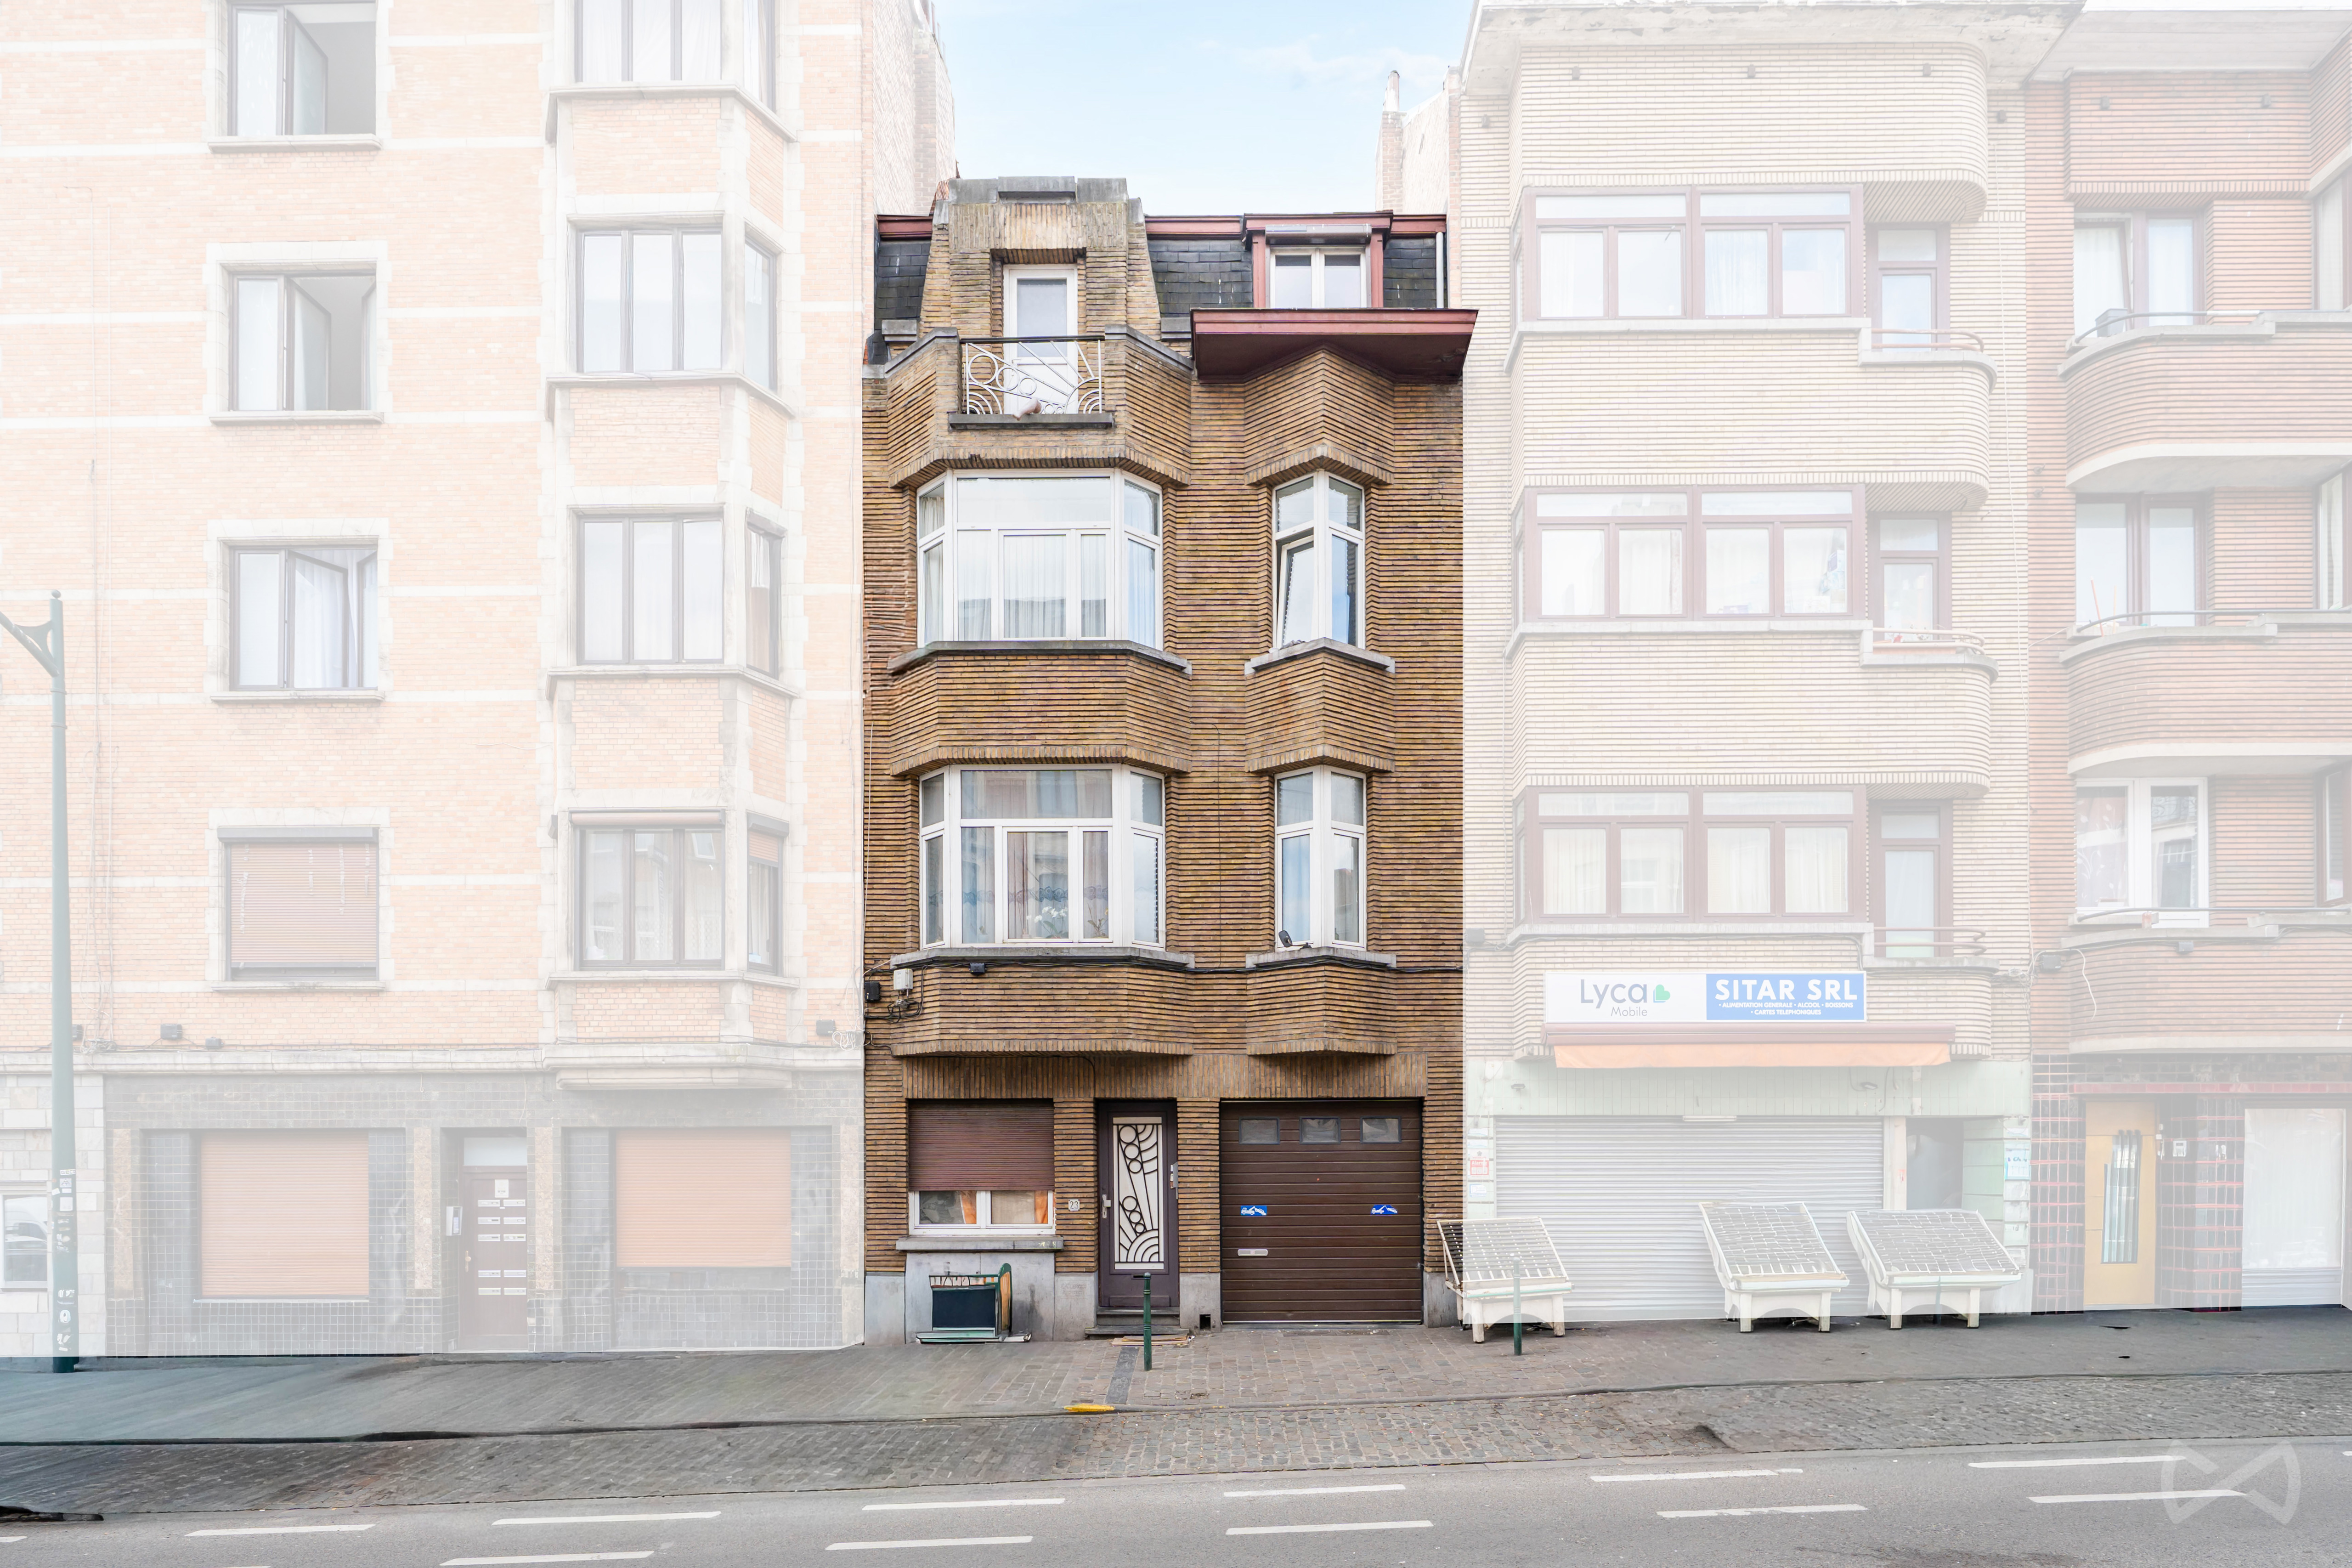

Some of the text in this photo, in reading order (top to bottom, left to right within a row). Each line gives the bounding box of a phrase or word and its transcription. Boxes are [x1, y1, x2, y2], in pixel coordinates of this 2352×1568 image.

[1581, 979, 1647, 1008] Lyca
[1715, 979, 1857, 1000] SITAR SRL
[1611, 1006, 1647, 1016] Mobile
[1069, 1201, 1079, 1210] 23
